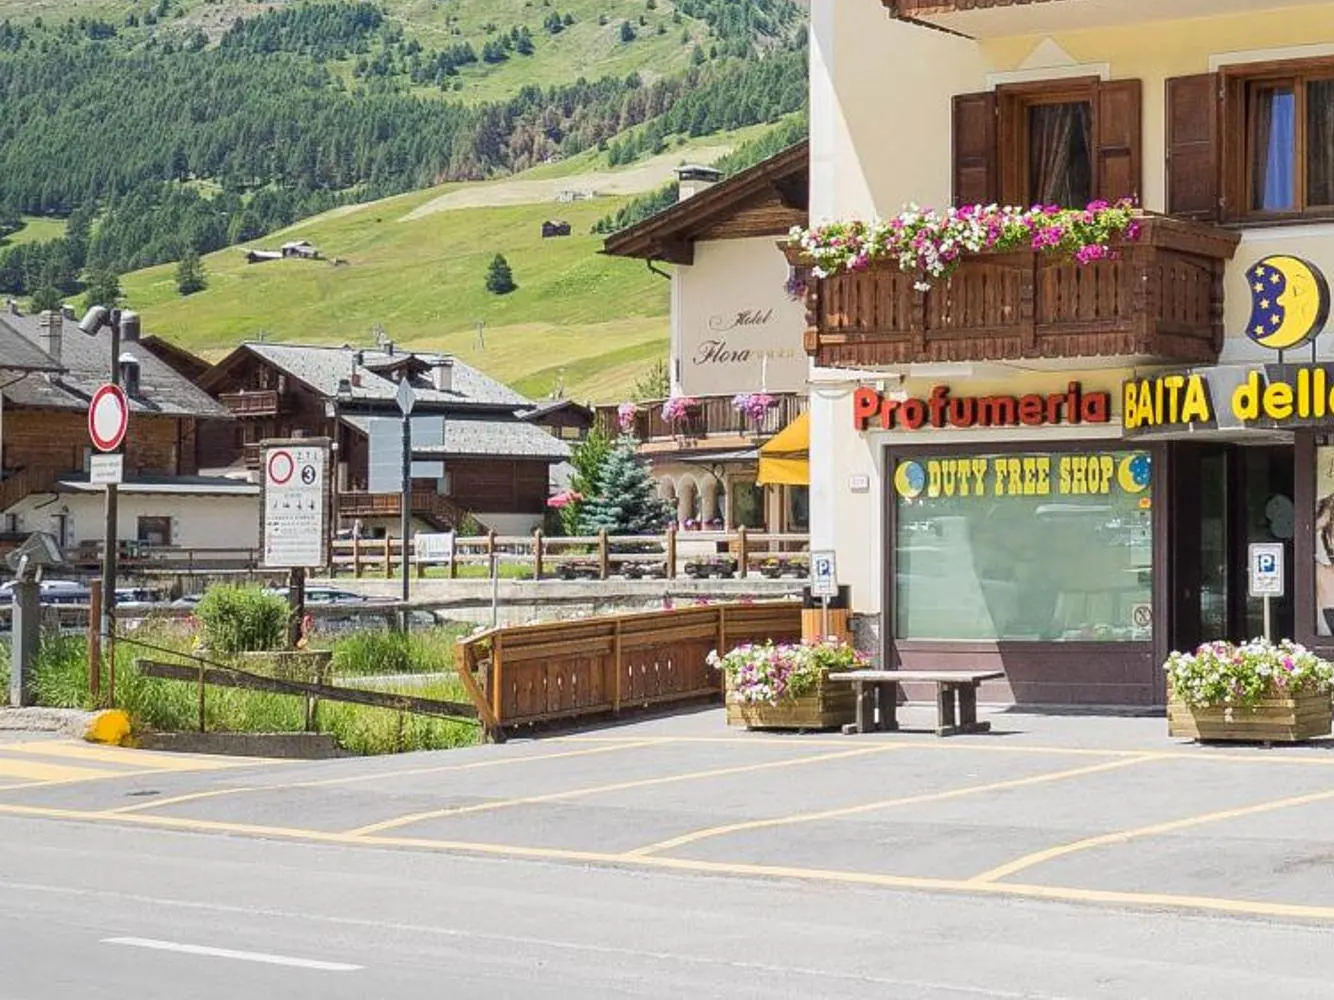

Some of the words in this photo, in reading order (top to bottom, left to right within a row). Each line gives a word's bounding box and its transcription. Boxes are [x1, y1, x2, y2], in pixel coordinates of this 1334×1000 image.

[692, 339, 750, 366] Flora
[853, 381, 1111, 431] Profumeria
[1123, 374, 1210, 430] BAITA
[927, 459, 988, 498] DUTY
[995, 456, 1051, 496] FREE
[1059, 454, 1115, 495] SHOP
